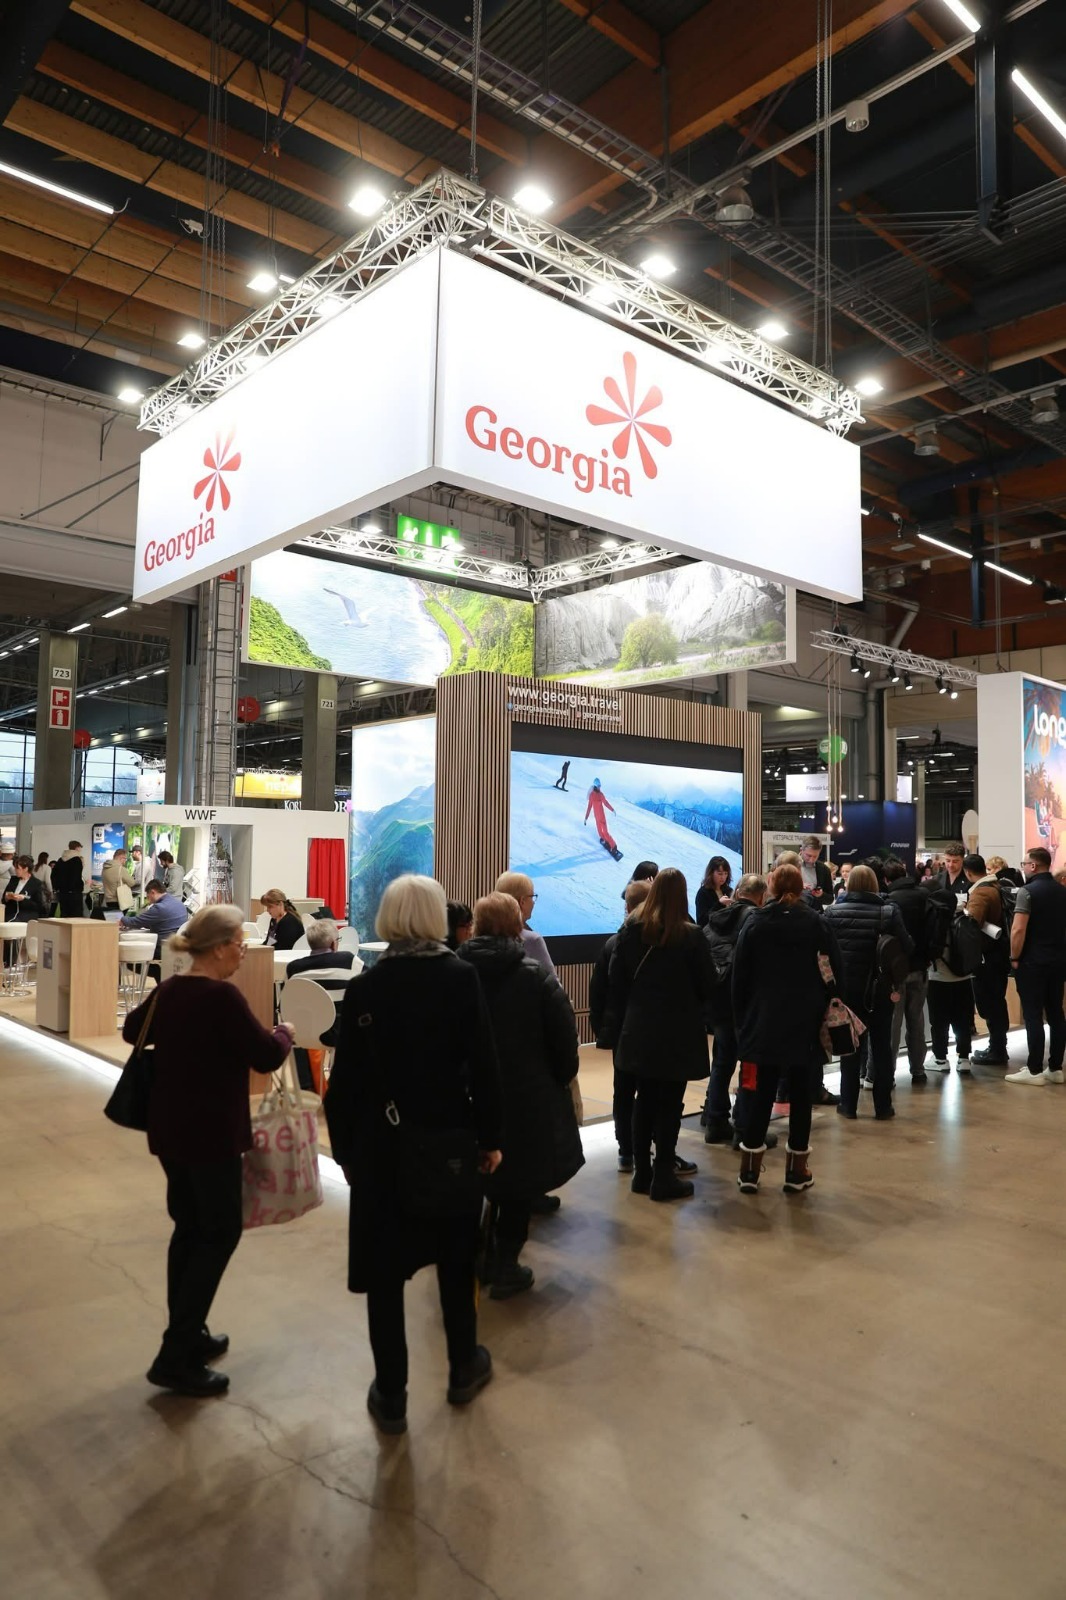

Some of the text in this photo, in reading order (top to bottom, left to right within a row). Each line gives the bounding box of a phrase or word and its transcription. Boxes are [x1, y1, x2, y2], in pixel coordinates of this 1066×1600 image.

[465, 405, 633, 498] Georgia
[143, 512, 216, 572] Georgia
[54, 669, 70, 678] 723
[322, 700, 334, 708] 721
[508, 686, 622, 711] www.georgia.travel
[284, 800, 302, 811] KOR
[73, 811, 87, 821] WWF
[184, 809, 217, 821] WWF
